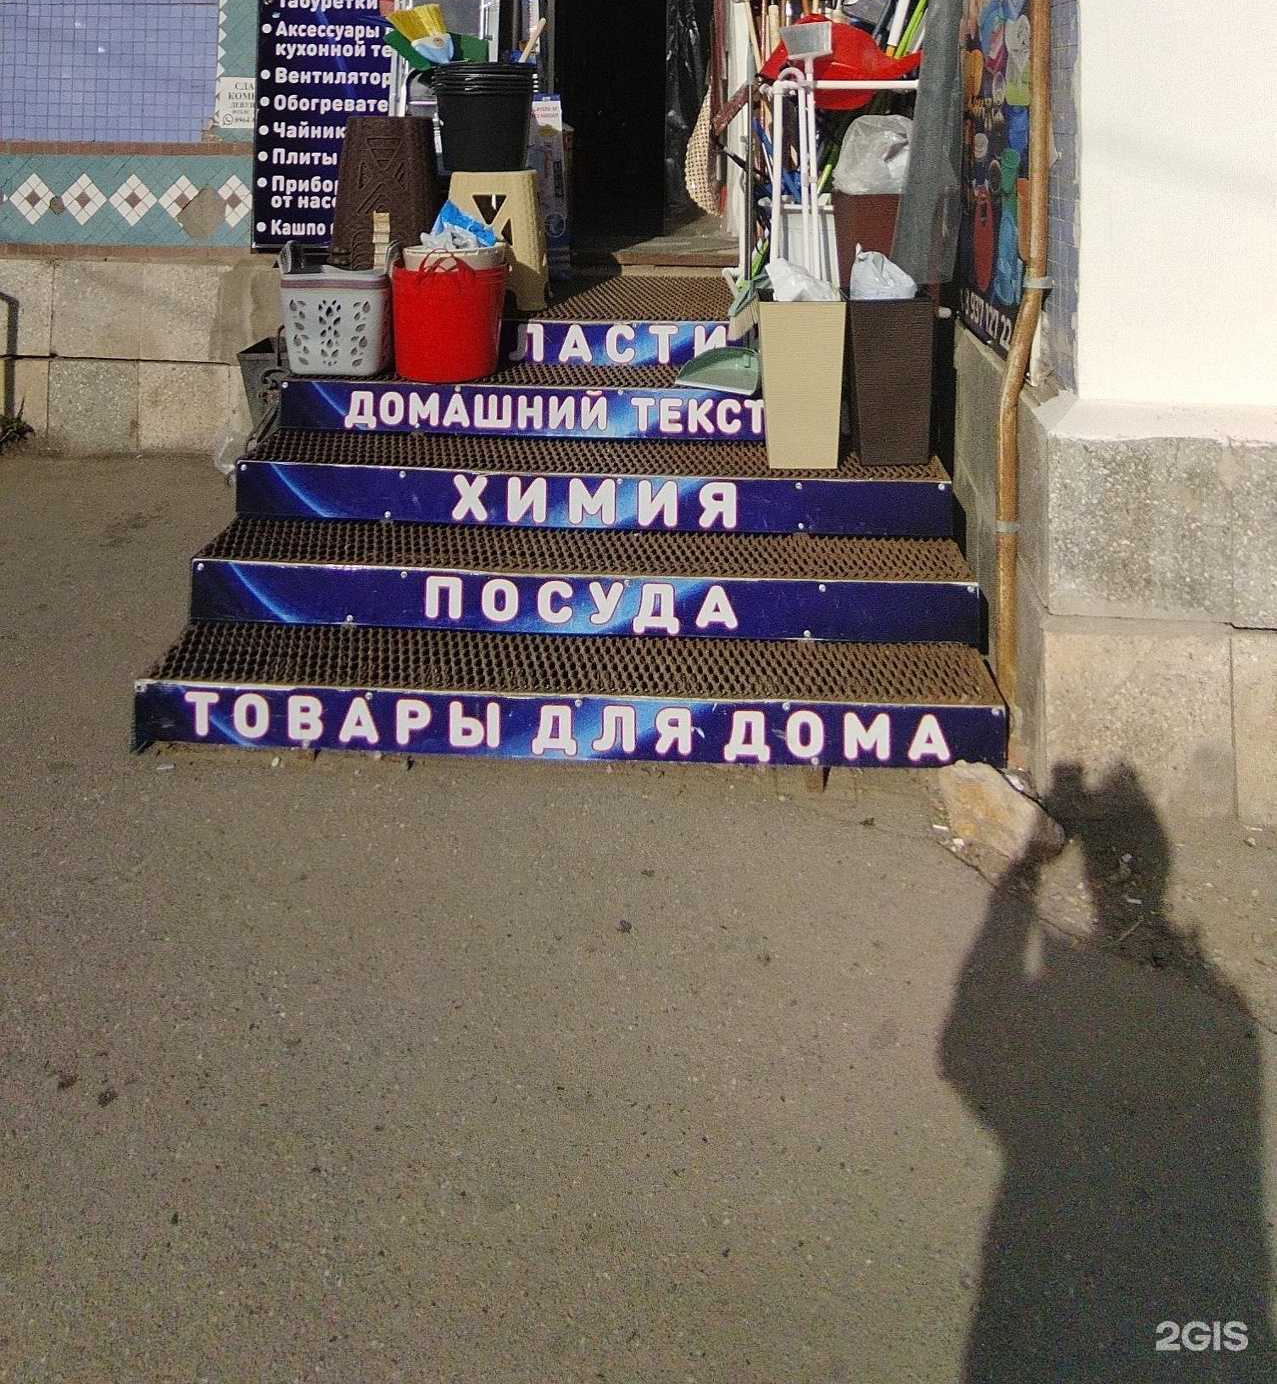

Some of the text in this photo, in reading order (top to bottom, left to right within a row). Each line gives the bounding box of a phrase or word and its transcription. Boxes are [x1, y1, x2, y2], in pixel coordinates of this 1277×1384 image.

[275, 23, 380, 42] Аксессуары
[275, 41, 366, 58] кухонной
[274, 69, 392, 89] Вентилятор
[273, 95, 389, 115] Обогревате
[272, 121, 346, 140] Чайник
[272, 148, 338, 166] Плиты
[271, 195, 293, 208] от
[271, 219, 326, 236] Кашпо
[344, 390, 765, 434] ДОМАШНИЙ ТЕКСТ
[452, 474, 738, 529] ХИМИЯ
[424, 574, 739, 635] ПОСУДА
[185, 690, 951, 763] ТОВАРЫ ДЛЯ ДОМА
